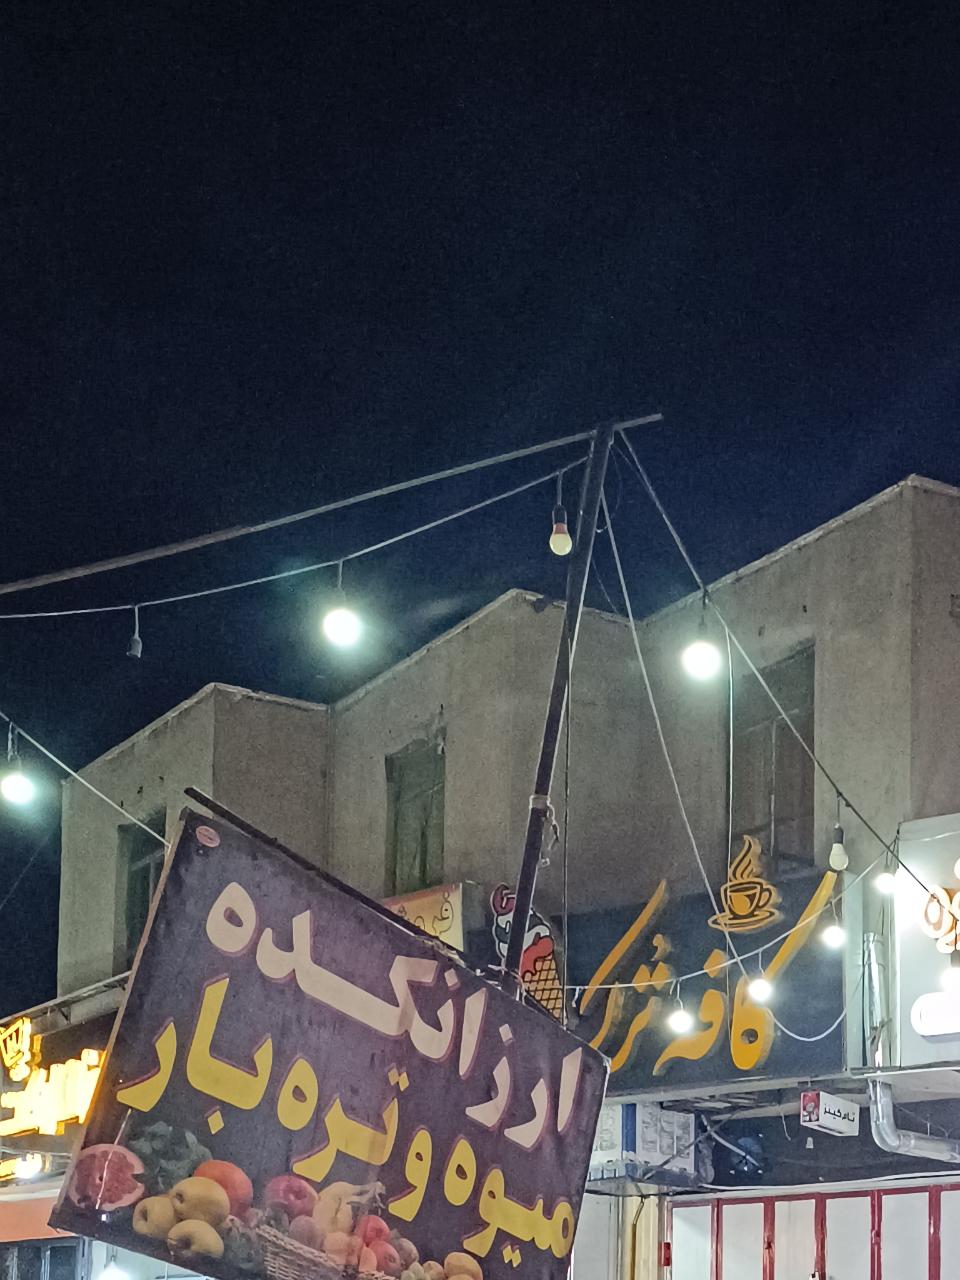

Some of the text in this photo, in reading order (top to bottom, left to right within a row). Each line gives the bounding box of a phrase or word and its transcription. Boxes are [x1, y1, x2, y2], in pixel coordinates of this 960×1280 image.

[206, 880, 584, 1150] ارزانکده
[654, 870, 837, 1075] کافه
[388, 1128, 433, 1222] و
[462, 1136, 576, 1268] میوه
